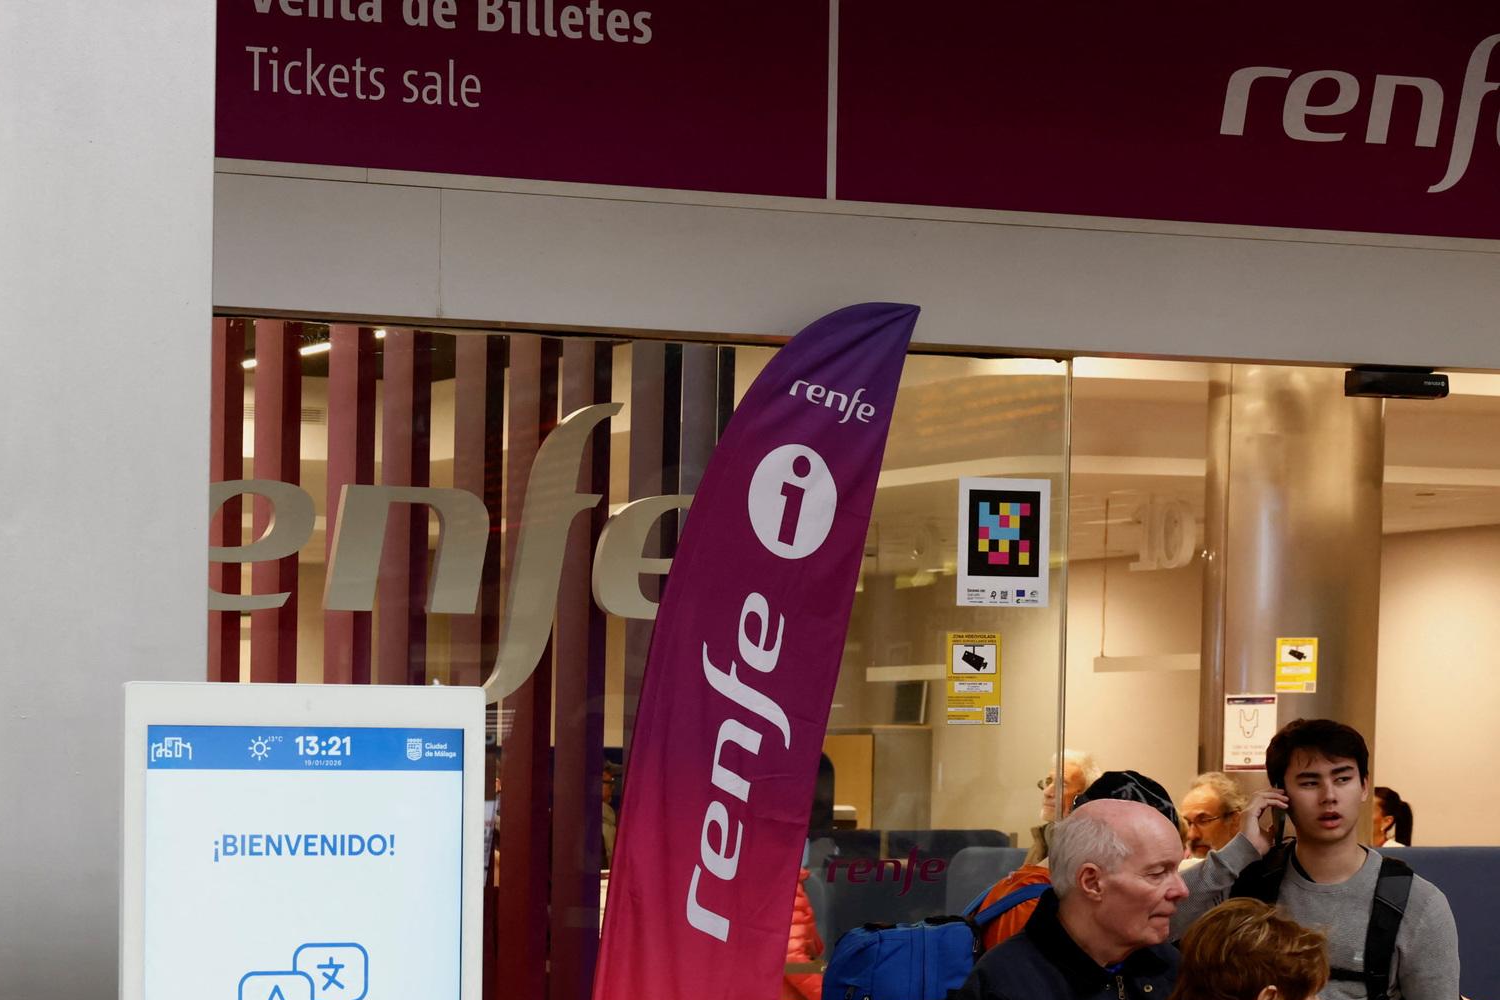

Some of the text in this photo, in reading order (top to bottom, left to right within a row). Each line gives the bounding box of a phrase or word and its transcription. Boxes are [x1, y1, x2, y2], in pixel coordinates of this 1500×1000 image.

[477, 0, 653, 45] Billetes
[245, 46, 481, 107] Tickets sale
[1219, 33, 1500, 193] renf
[788, 379, 876, 424] renfe
[295, 736, 351, 756] 13:21
[425, 742, 447, 750] Ciudad
[434, 750, 457, 759] Málaga
[687, 592, 791, 943] renfe
[213, 833, 395, 862] ¡BIENVENIDO!
[826, 845, 947, 897] renfe
